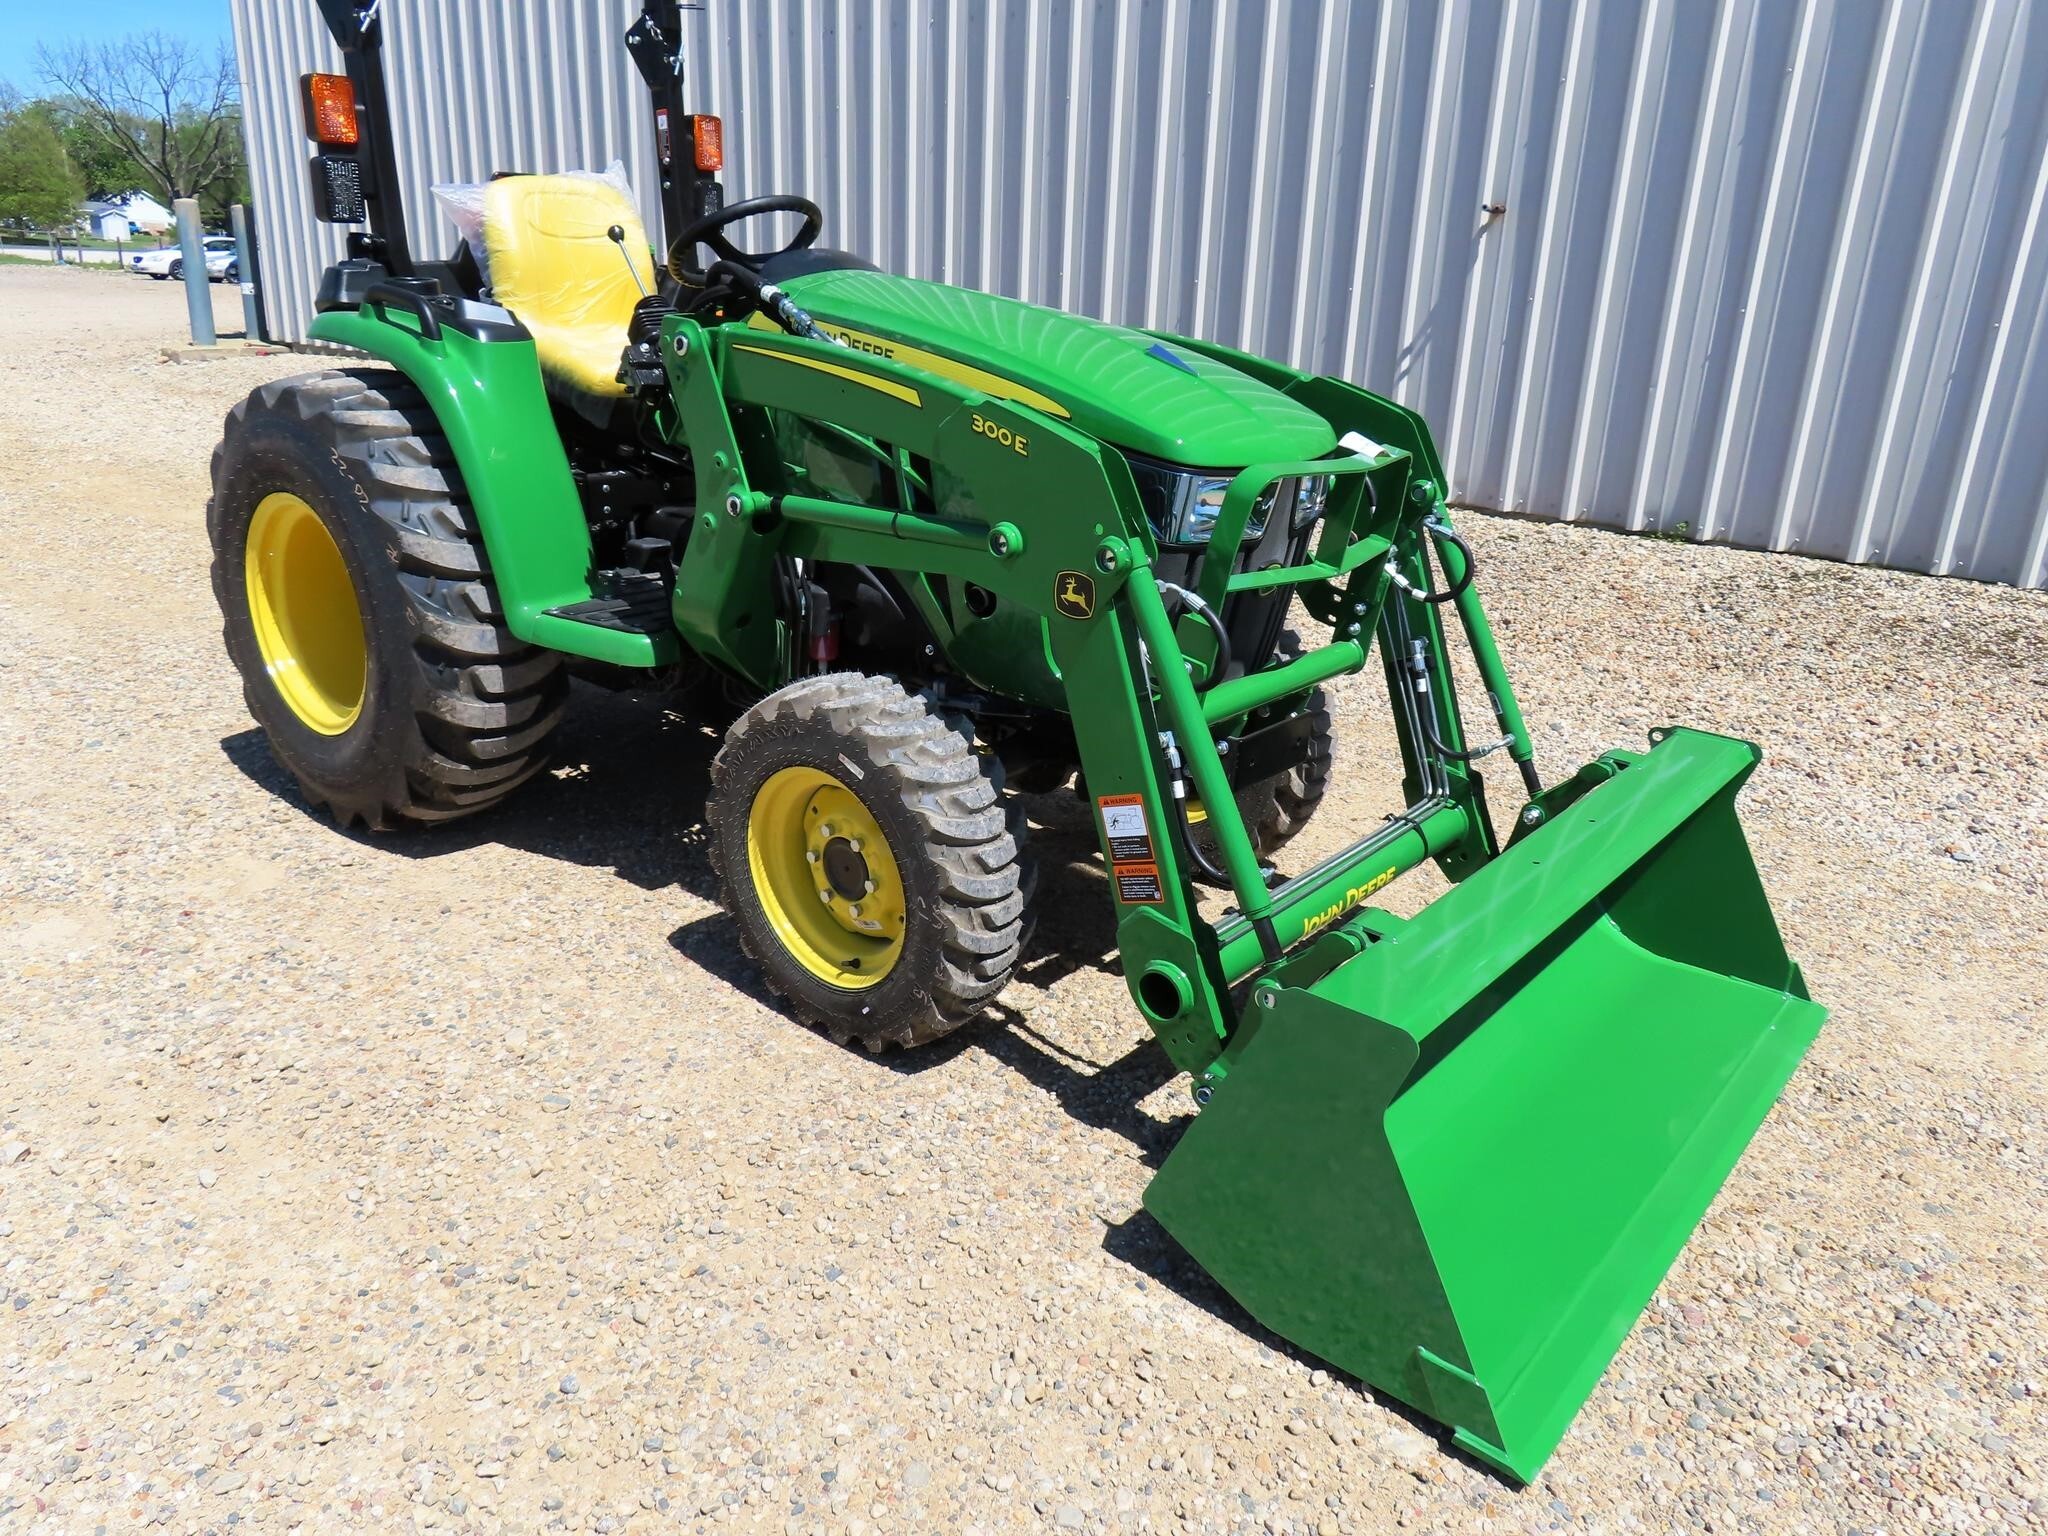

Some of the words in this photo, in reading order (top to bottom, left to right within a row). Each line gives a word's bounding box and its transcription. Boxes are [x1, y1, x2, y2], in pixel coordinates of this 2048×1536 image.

[840, 331, 895, 359] DEERE
[971, 413, 1028, 457] 300E
[1109, 796, 1138, 805] WARNING
[1302, 899, 1344, 938] JOHN
[1346, 865, 1397, 910] DEERE
